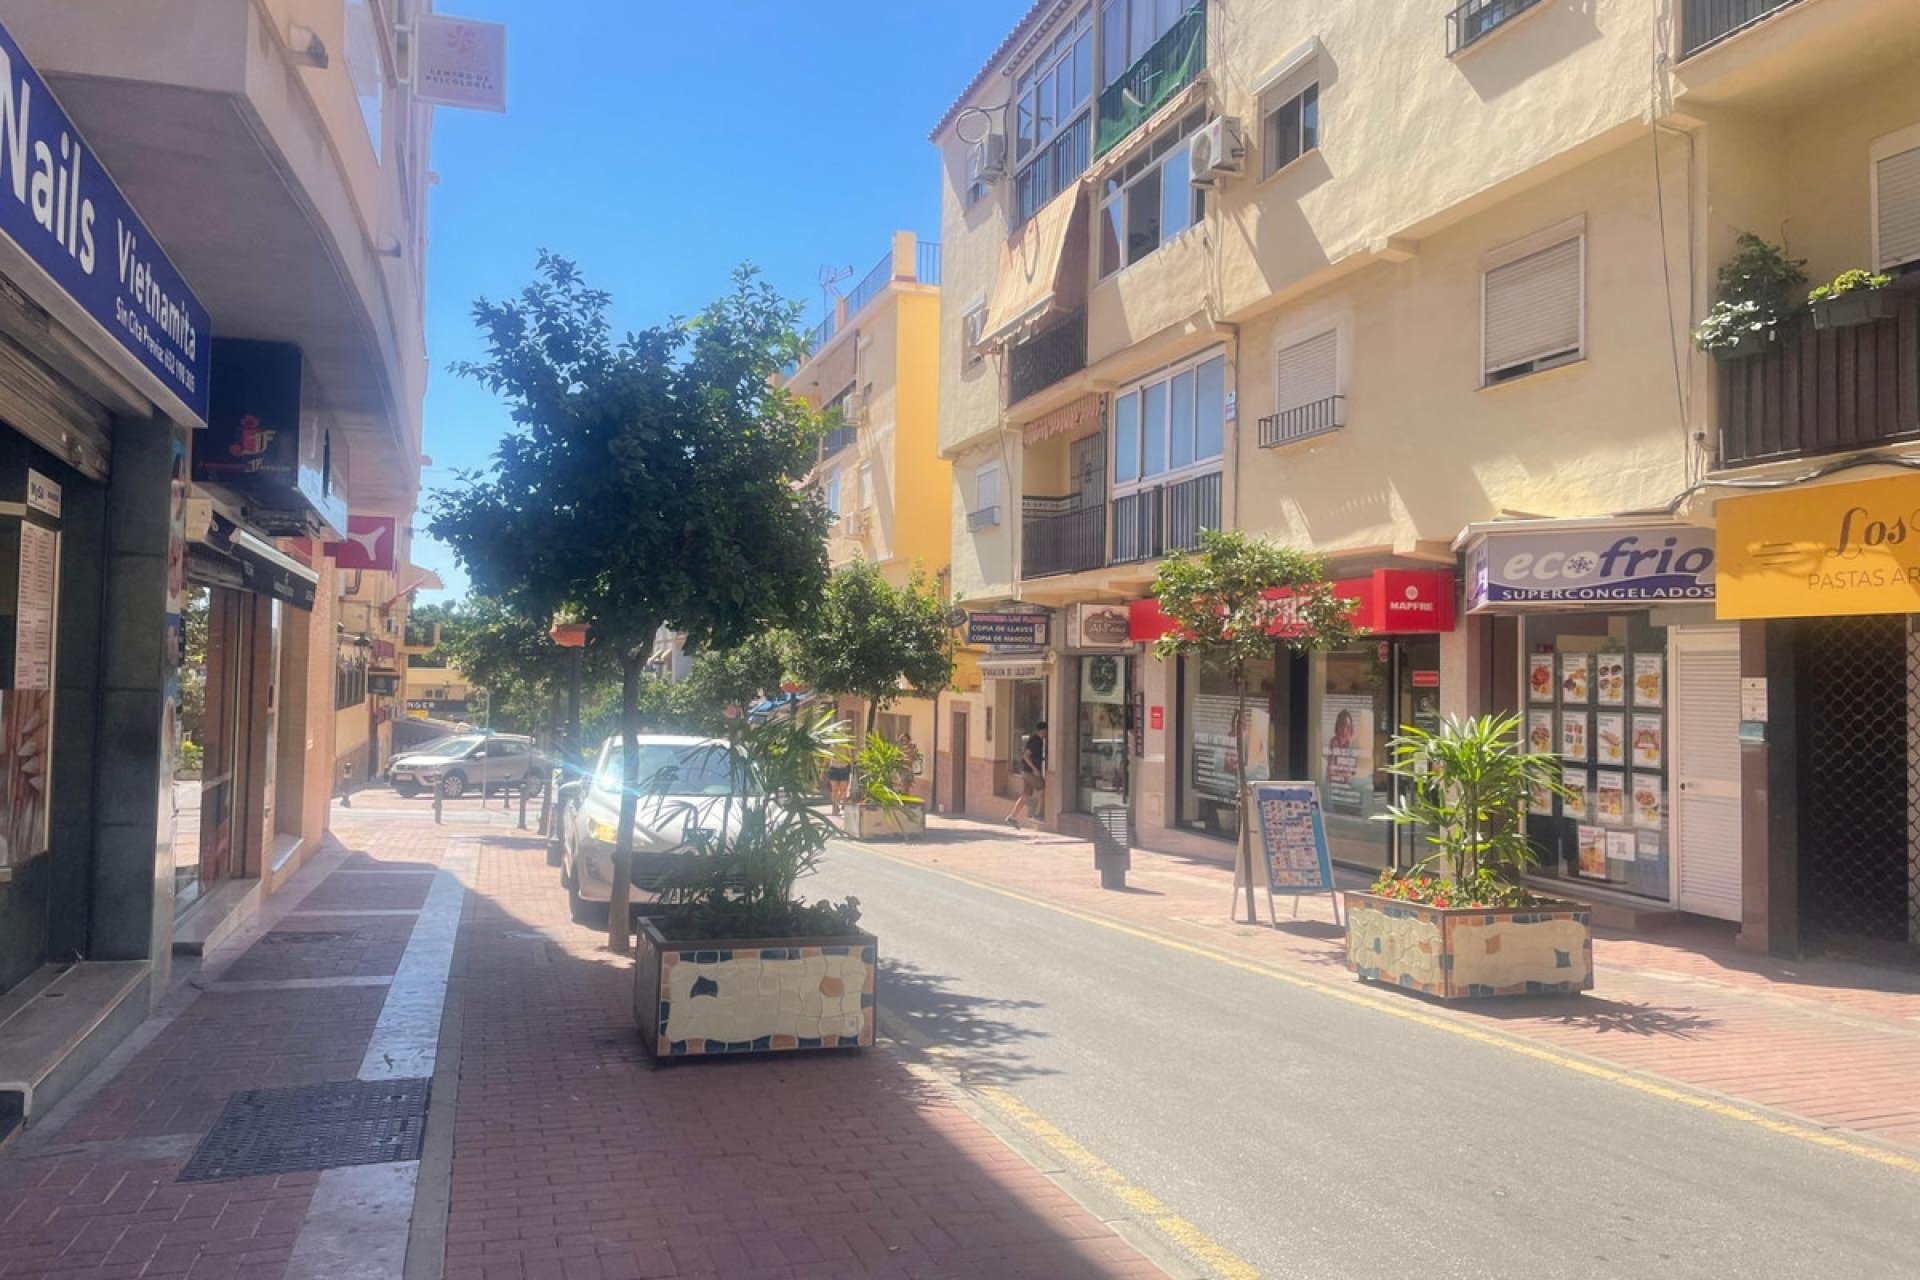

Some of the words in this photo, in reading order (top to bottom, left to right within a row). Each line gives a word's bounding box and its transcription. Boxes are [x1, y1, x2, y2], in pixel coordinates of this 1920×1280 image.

[0, 46, 96, 275] Nails
[117, 218, 196, 362] Vietnamita
[129, 310, 142, 342] Cita
[1824, 506, 1907, 560] Los
[1503, 536, 1715, 580] ecofrio
[1503, 586, 1715, 600] SUPERCONGELADOS
[1807, 569, 1885, 592] PASTAS
[1390, 601, 1433, 611] MAPFRE
[1003, 635, 1033, 643] MANDOS
